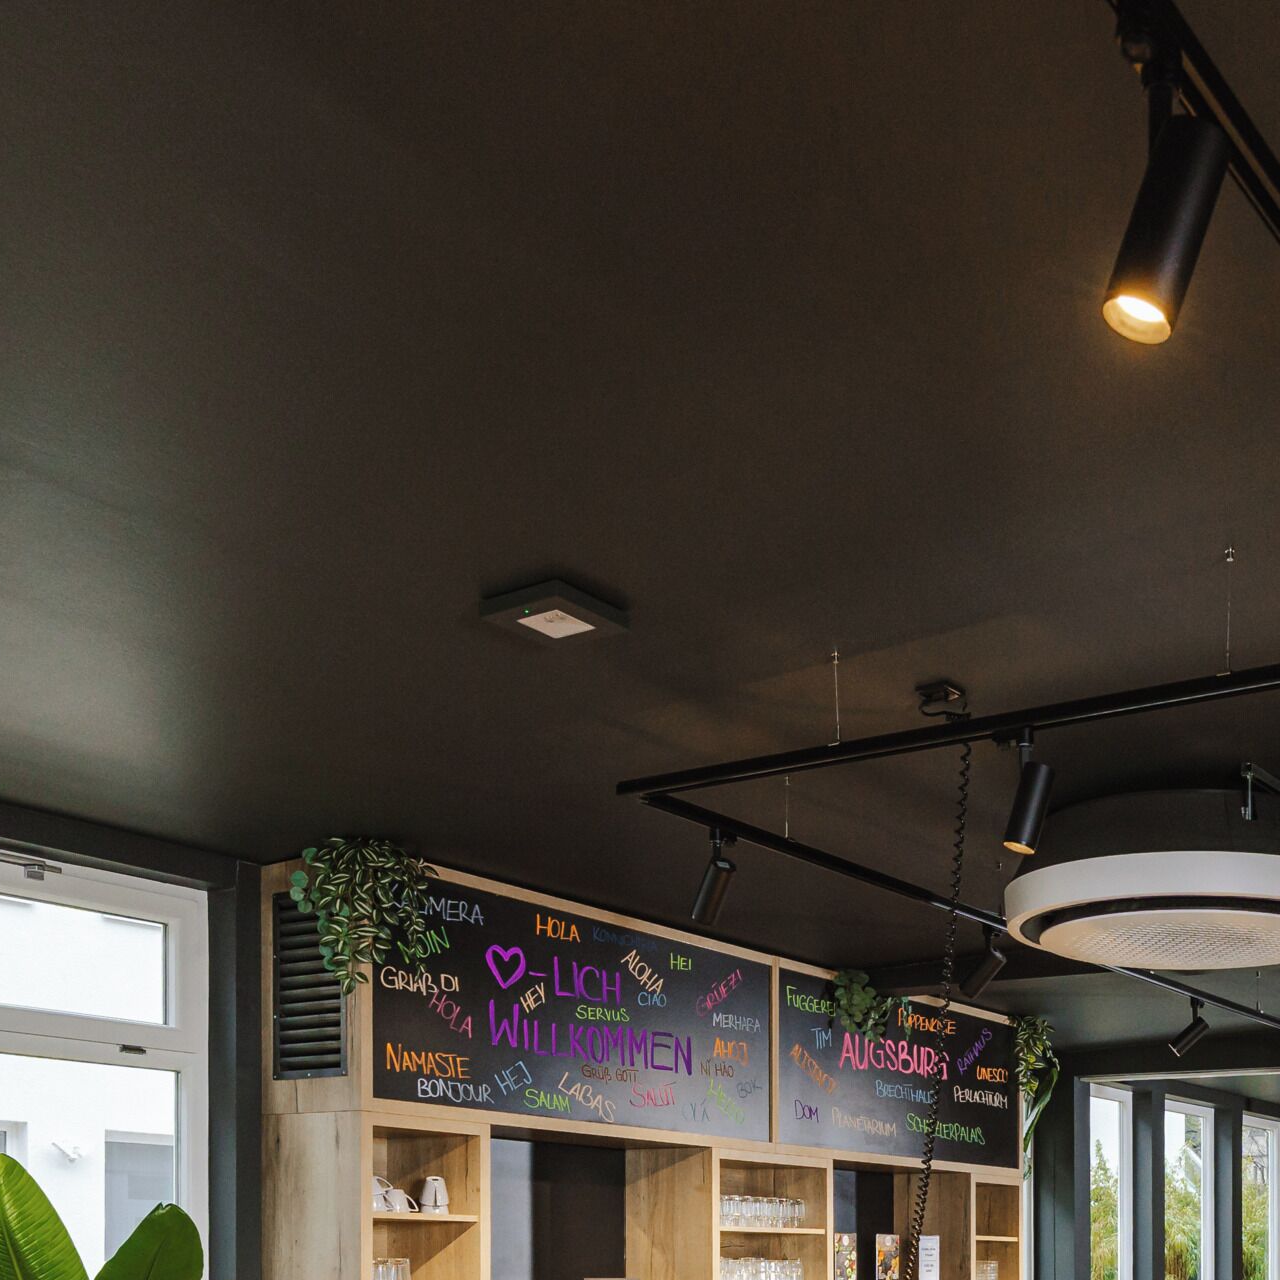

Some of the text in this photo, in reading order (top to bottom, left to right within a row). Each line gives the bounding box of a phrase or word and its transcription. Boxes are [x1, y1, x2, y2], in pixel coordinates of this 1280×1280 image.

[536, 913, 581, 944] HOLA
[397, 926, 450, 964] MOIN
[621, 949, 664, 995] ALOHA
[670, 952, 692, 971] HEI
[440, 974, 460, 992] DI
[520, 982, 546, 1014] HEY
[695, 968, 744, 1017] GRÜEZI
[428, 989, 473, 1039] HOLA
[575, 1005, 630, 1023] SERVUS
[637, 991, 667, 1008] CIAO
[786, 985, 837, 1017] FUGGEREI
[489, 999, 693, 1076] WILLKOMMEN
[712, 1012, 761, 1033] MERHABA
[713, 1036, 750, 1067] AHOJ
[810, 1027, 833, 1050] TIM
[956, 1027, 993, 1075] RATHAUS
[385, 1042, 471, 1079] NAMASTE
[839, 1031, 950, 1080] AUGSBURG
[494, 1060, 533, 1096] HEJ
[615, 1068, 639, 1083] GOTT
[976, 1064, 1009, 1083] UNESCO
[417, 1077, 495, 1104] BONJOUR
[523, 1088, 572, 1113] SALAM
[558, 1071, 616, 1123] LABAS
[629, 1082, 678, 1108] SALUT
[953, 1085, 1009, 1110] PERLACHTURM
[795, 1099, 820, 1123] DOM
[831, 1106, 897, 1137] PLANETARIUM
